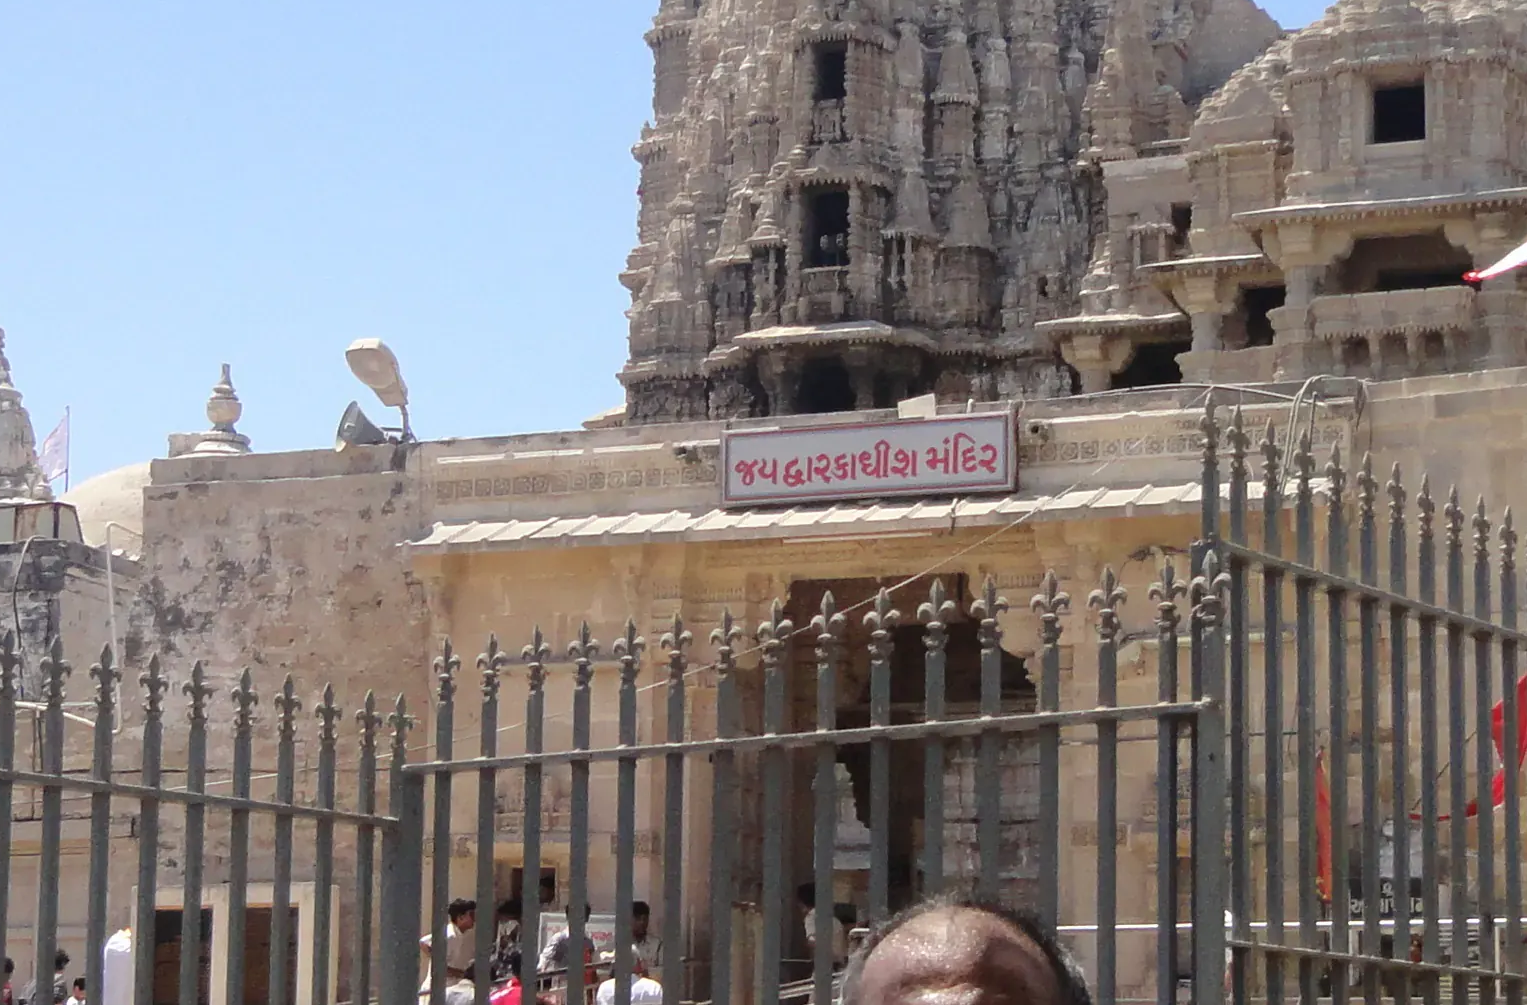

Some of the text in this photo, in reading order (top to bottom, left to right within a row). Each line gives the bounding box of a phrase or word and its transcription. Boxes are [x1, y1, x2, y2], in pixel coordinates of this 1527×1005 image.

[734, 432, 999, 488] જય દ્વારકાધીશ મંદિર
